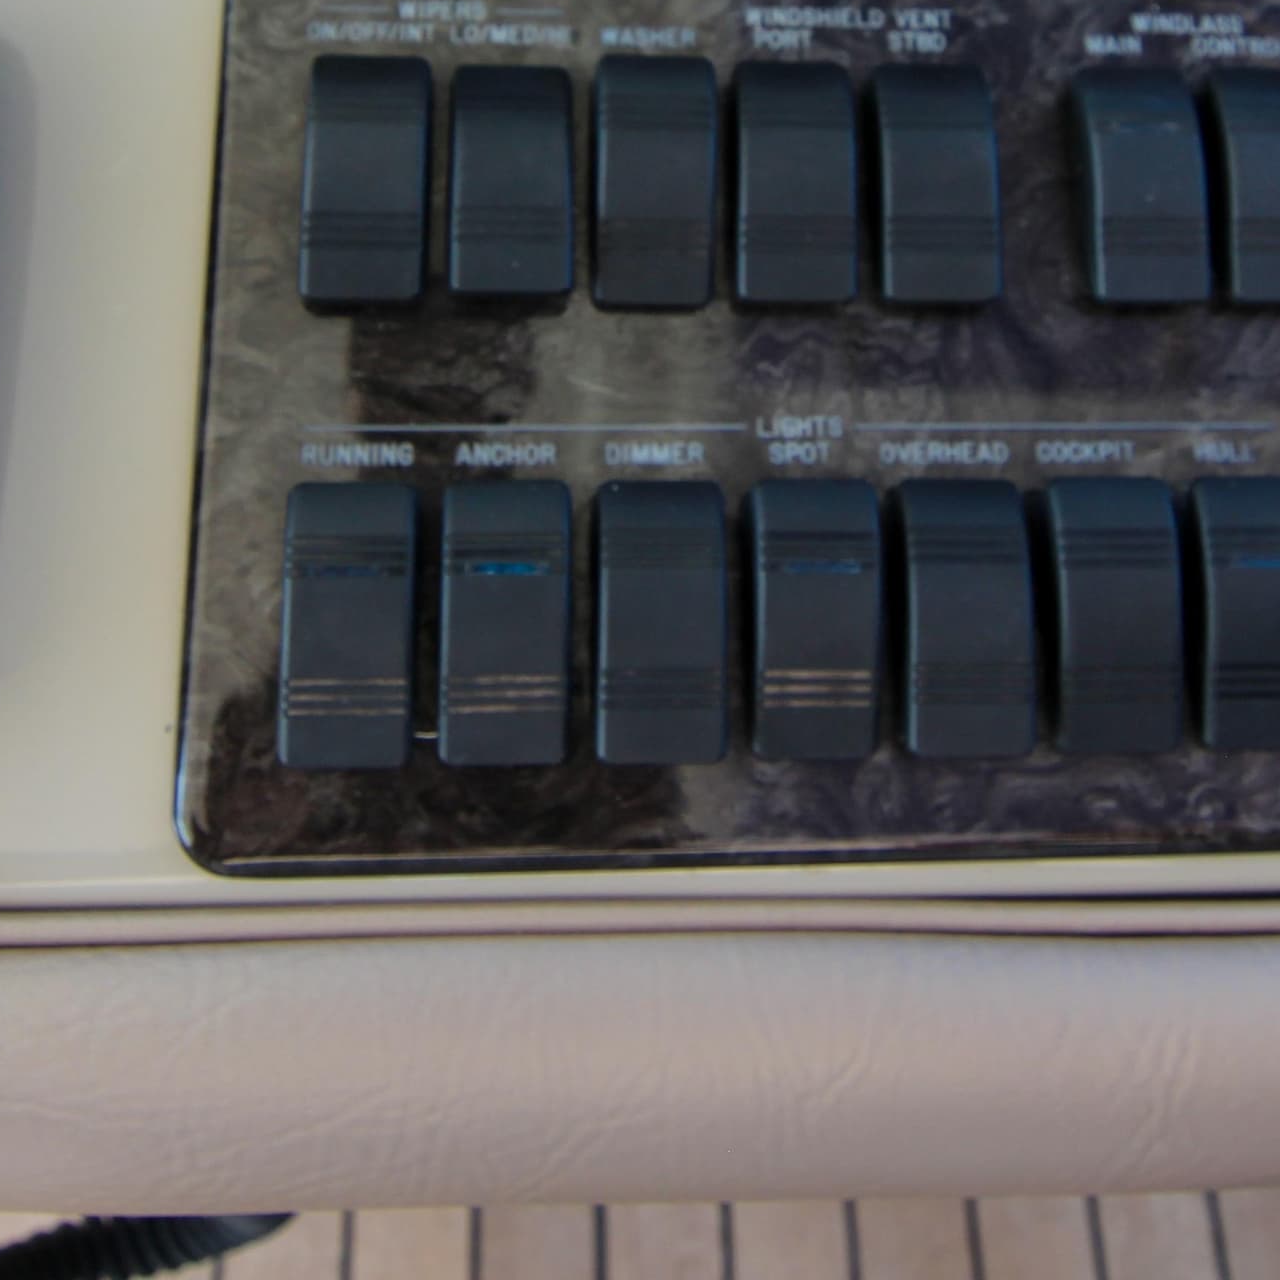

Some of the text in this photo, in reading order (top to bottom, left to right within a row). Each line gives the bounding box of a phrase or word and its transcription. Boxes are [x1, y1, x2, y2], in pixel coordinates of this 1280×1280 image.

[397, 0, 487, 22] WIPERS
[745, 6, 953, 31] WINDSHIELD VENT
[307, 22, 435, 44] ON/OFF/INT
[1130, 13, 1244, 36] WINDLASS
[599, 26, 697, 49] WASHER
[753, 29, 813, 51] PORT
[887, 30, 948, 54] STBD
[1084, 35, 1143, 56] MAIN
[756, 415, 844, 440] LIGHTS
[300, 441, 415, 468] RUNNING
[455, 440, 558, 467] ANCHOR
[604, 440, 706, 467] DIMMER
[766, 440, 832, 466] SPOT
[878, 439, 1010, 466] OVERHEAD
[1034, 438, 1138, 464] COCKPIT
